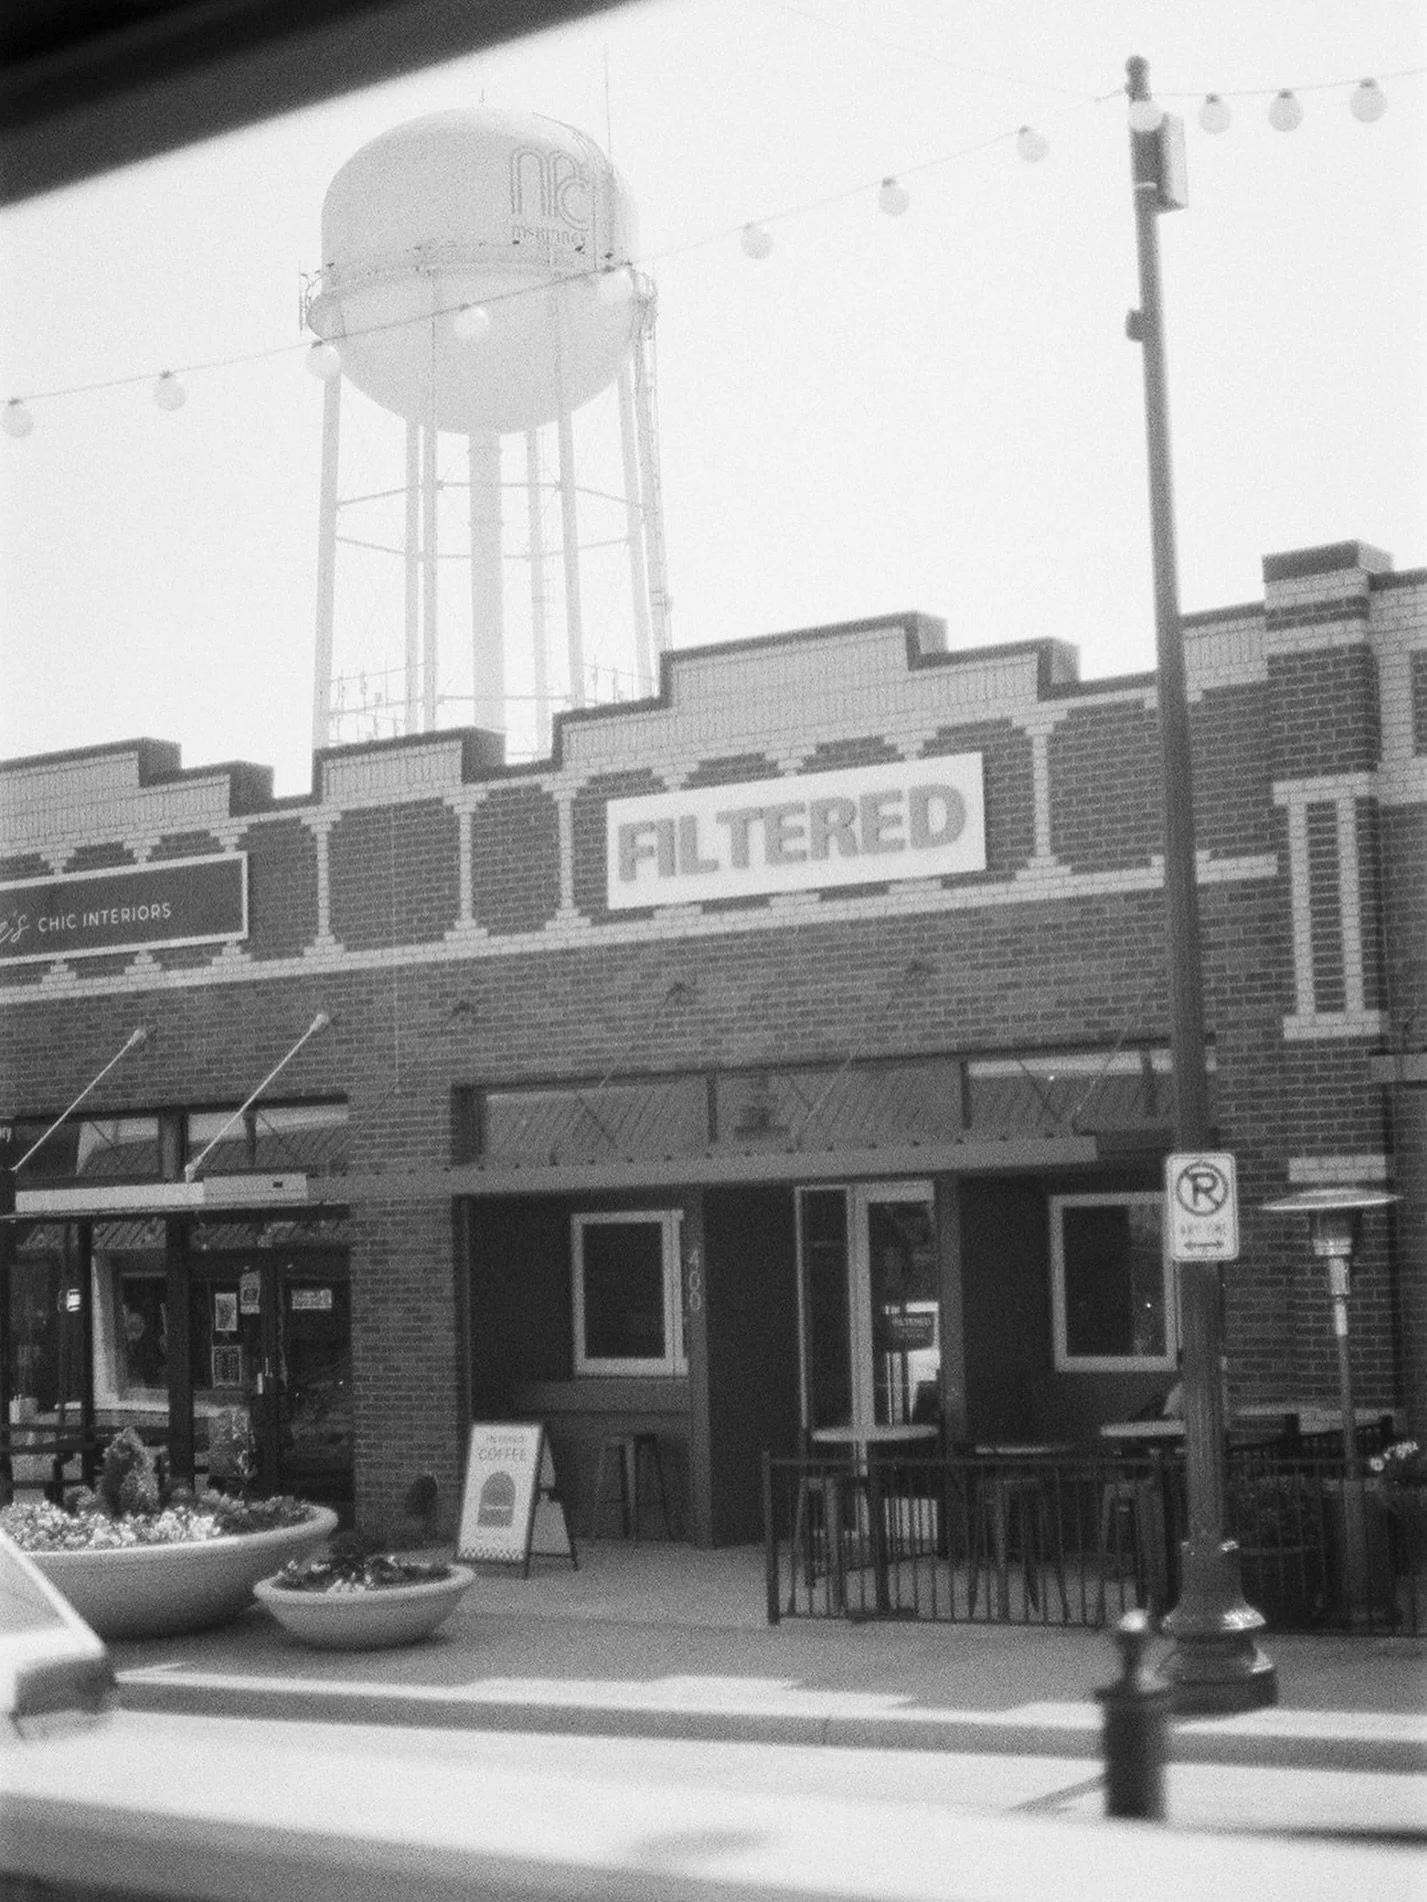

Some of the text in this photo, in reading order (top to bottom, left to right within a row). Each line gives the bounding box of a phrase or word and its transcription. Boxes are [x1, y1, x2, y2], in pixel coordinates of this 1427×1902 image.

[618, 784, 966, 882] FILTERED
[38, 914, 76, 933] CHIC
[83, 903, 171, 927] INTERIORS
